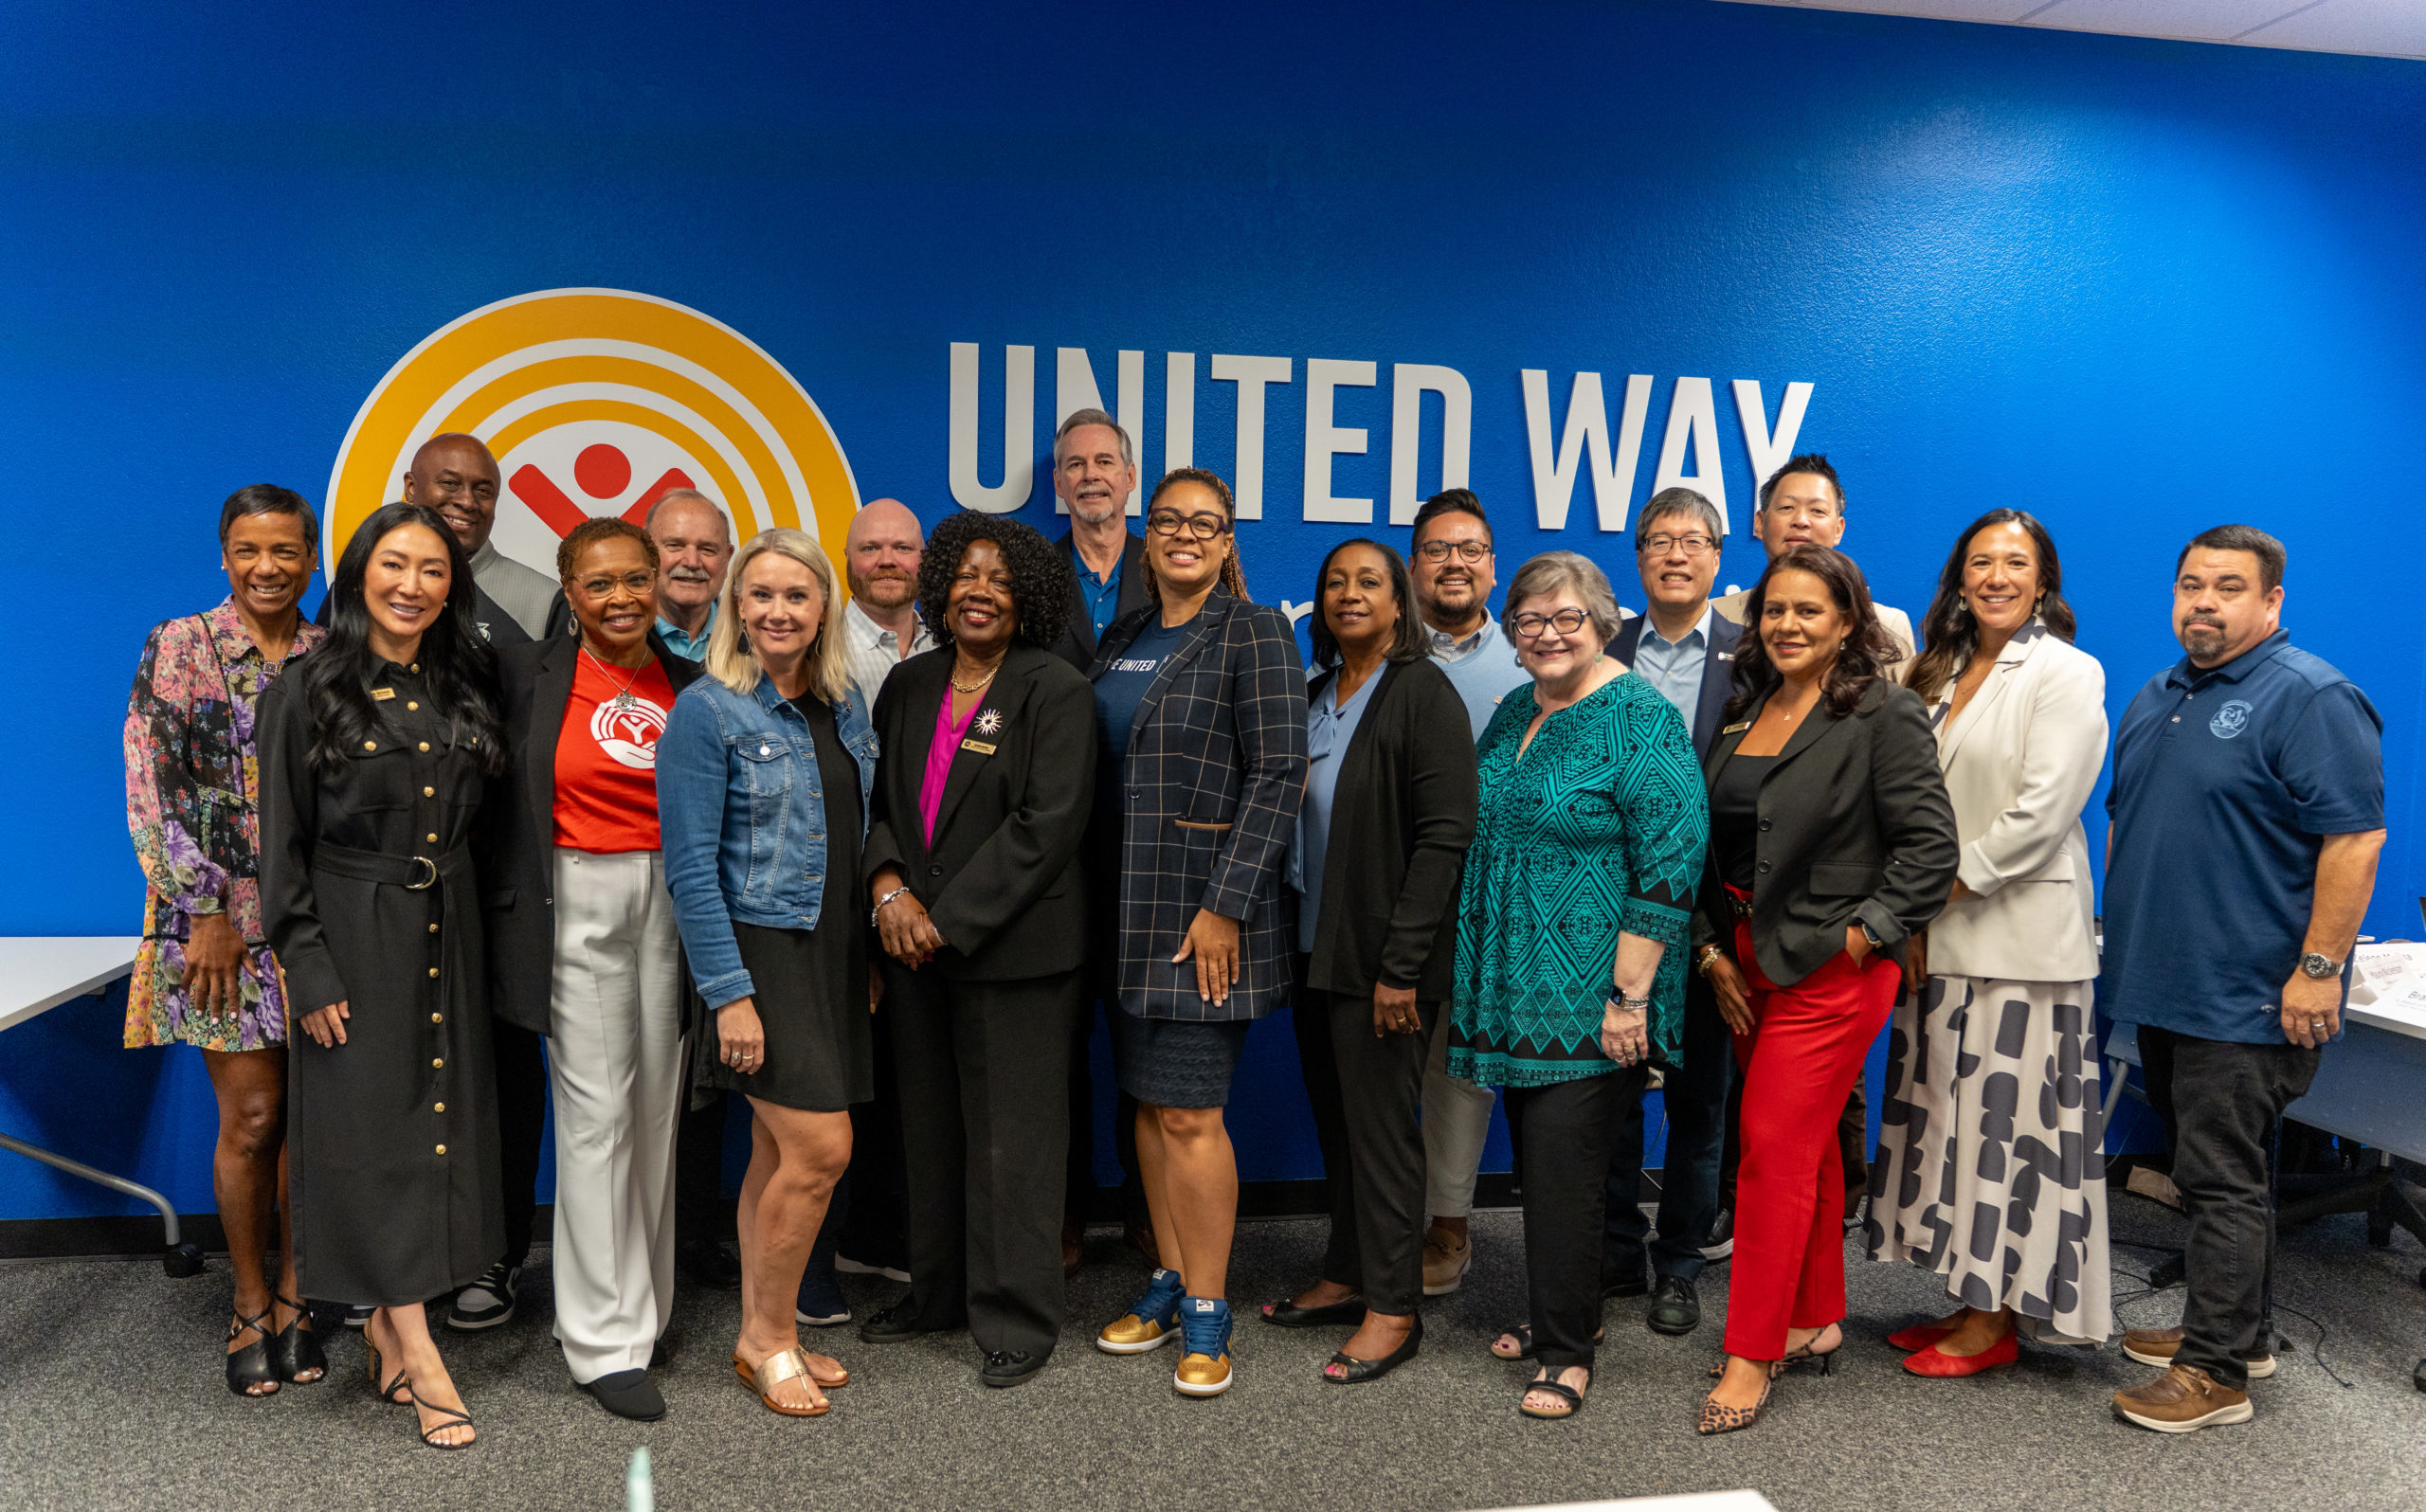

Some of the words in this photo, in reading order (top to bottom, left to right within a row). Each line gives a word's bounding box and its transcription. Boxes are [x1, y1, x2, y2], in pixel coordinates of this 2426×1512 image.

[948, 341, 1473, 527] UNITED
[1521, 368, 1816, 537] WAY
[1117, 658, 1156, 672] UNITED
